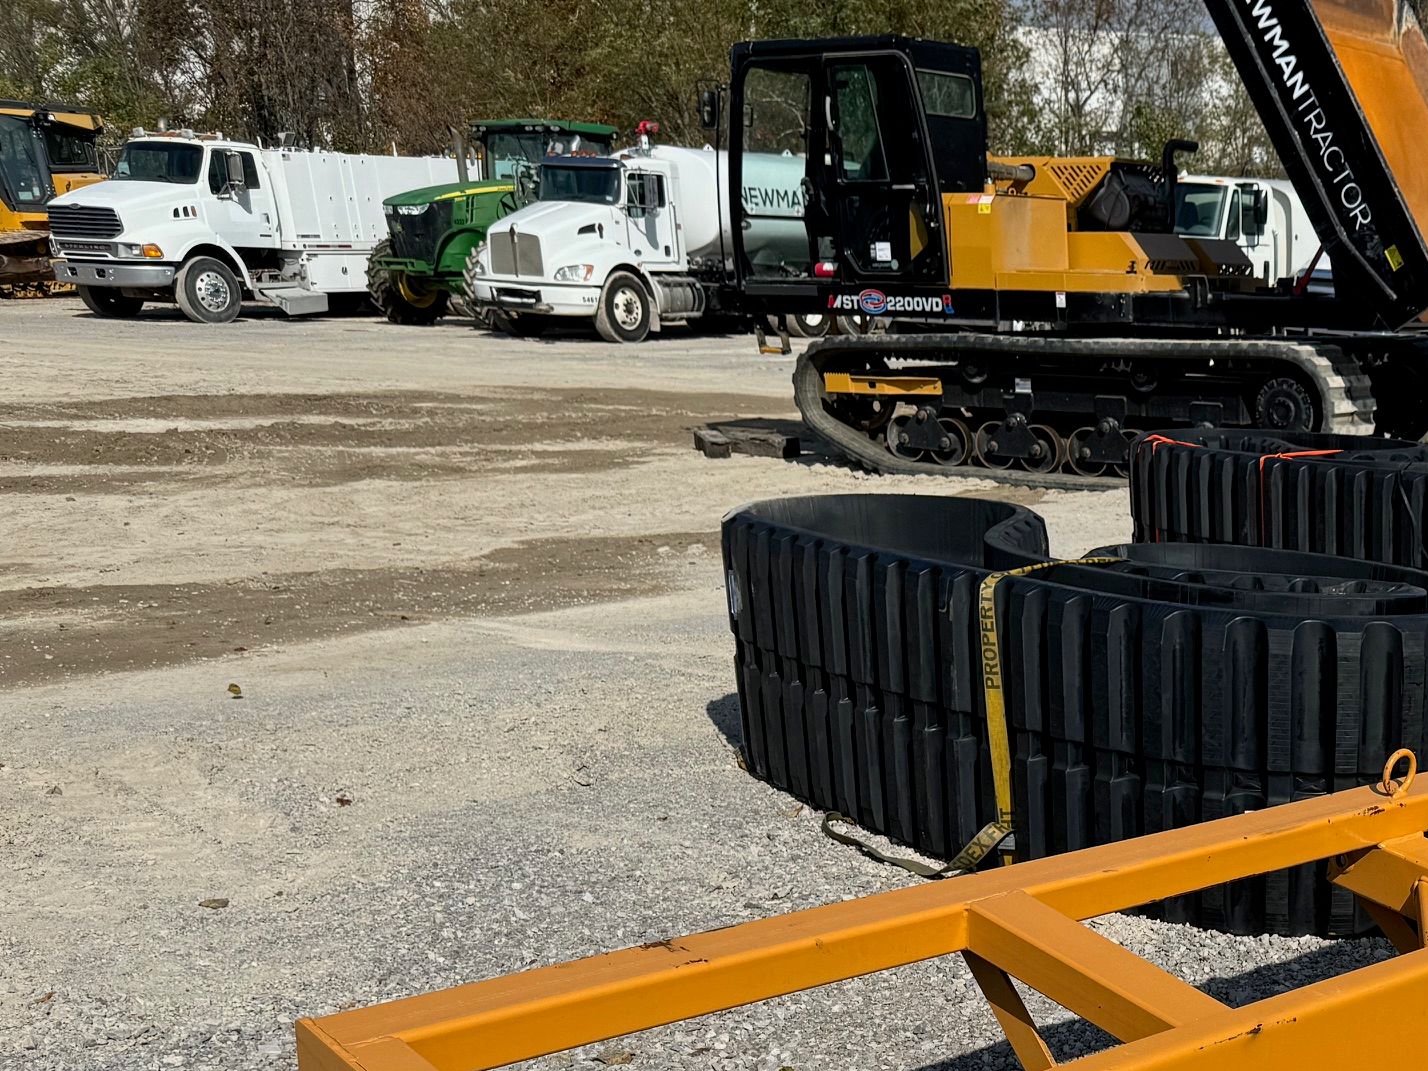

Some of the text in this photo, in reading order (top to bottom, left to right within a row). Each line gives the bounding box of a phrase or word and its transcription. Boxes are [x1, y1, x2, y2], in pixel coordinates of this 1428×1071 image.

[1246, 0, 1372, 231] WMANTRACTOR
[741, 185, 808, 209] NEWMA
[979, 580, 1001, 690] PROPERTY
